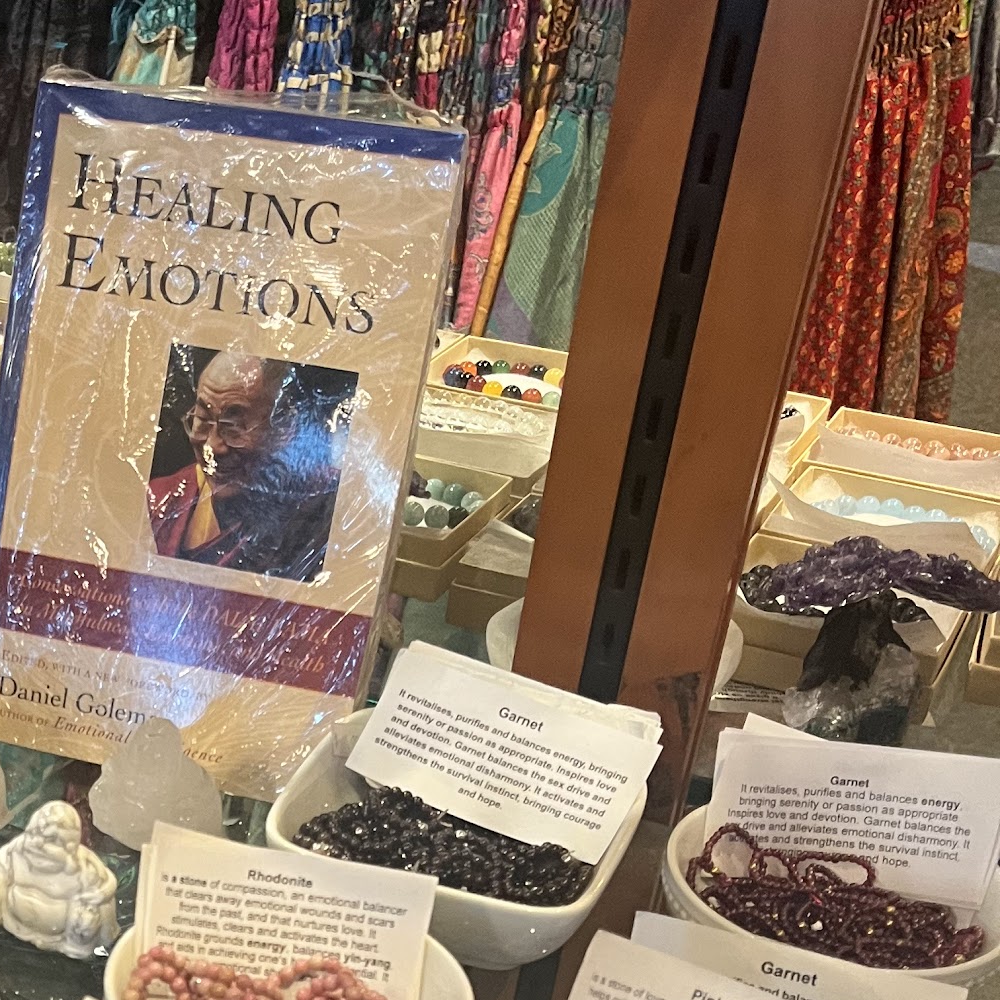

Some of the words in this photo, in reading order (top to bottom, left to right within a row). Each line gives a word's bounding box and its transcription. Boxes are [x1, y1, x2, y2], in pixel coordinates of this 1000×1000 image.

[68, 152, 341, 245] HEALING
[57, 231, 374, 335] EMOTIONS
[75, 693, 154, 725] Golem
[498, 706, 545, 733] Garnet
[53, 716, 132, 744] Emotional
[398, 688, 406, 697] It
[406, 693, 453, 718] revitalises,
[454, 713, 489, 731] purifies
[490, 727, 510, 738] and
[510, 733, 551, 754] balances
[552, 751, 585, 769] energy,
[588, 762, 628, 784] bringing
[390, 715, 409, 727] and
[409, 723, 451, 745] devotion.
[454, 740, 486, 758] Garnet
[487, 753, 528, 775] balances
[530, 770, 545, 781] the
[547, 778, 564, 788] sex
[566, 784, 590, 797] drive
[591, 794, 611, 805] and
[396, 703, 434, 724] serenity
[435, 720, 446, 728] or
[446, 725, 483, 743] passion
[484, 739, 496, 748] as
[498, 744, 552, 770] appropriate.
[556, 765, 594, 785] Inspires
[595, 779, 616, 792] love
[374, 737, 427, 764] strengthens
[430, 760, 444, 771] the
[446, 768, 483, 786] survival
[483, 781, 519, 802] instinct,
[522, 796, 562, 818] bringing
[563, 812, 601, 830] courage
[383, 726, 426, 749] alleviates
[428, 746, 475, 768] emotional
[475, 764, 531, 791] disharmony.
[533, 785, 541, 794] It
[542, 790, 584, 810] activates
[585, 806, 605, 817] and
[830, 776, 870, 788] Garnet
[457, 787, 476, 798] and
[477, 793, 501, 809] hope.
[739, 796, 776, 808] bringing
[779, 799, 819, 810] serenity
[822, 801, 833, 809] or
[835, 802, 877, 813] passion
[881, 806, 894, 815] as
[740, 783, 747, 792] It
[803, 787, 841, 797] purifies
[844, 790, 865, 799] and
[868, 791, 917, 804] balances
[727, 808, 763, 818] Inspires
[766, 809, 786, 819] love
[789, 811, 808, 820] and
[863, 815, 900, 828] Garnet
[904, 820, 951, 834] balances
[954, 826, 970, 836] the
[741, 821, 765, 830] drive
[768, 822, 786, 831] and
[789, 823, 837, 834] alleviates
[841, 828, 894, 839] emotional
[771, 835, 790, 843] and
[793, 836, 854, 848] strengthens
[858, 840, 875, 850] the
[878, 844, 919, 855] survival
[882, 855, 910, 867] hope.
[247, 869, 313, 889] Rhodonite
[760, 960, 818, 988] Garnet
